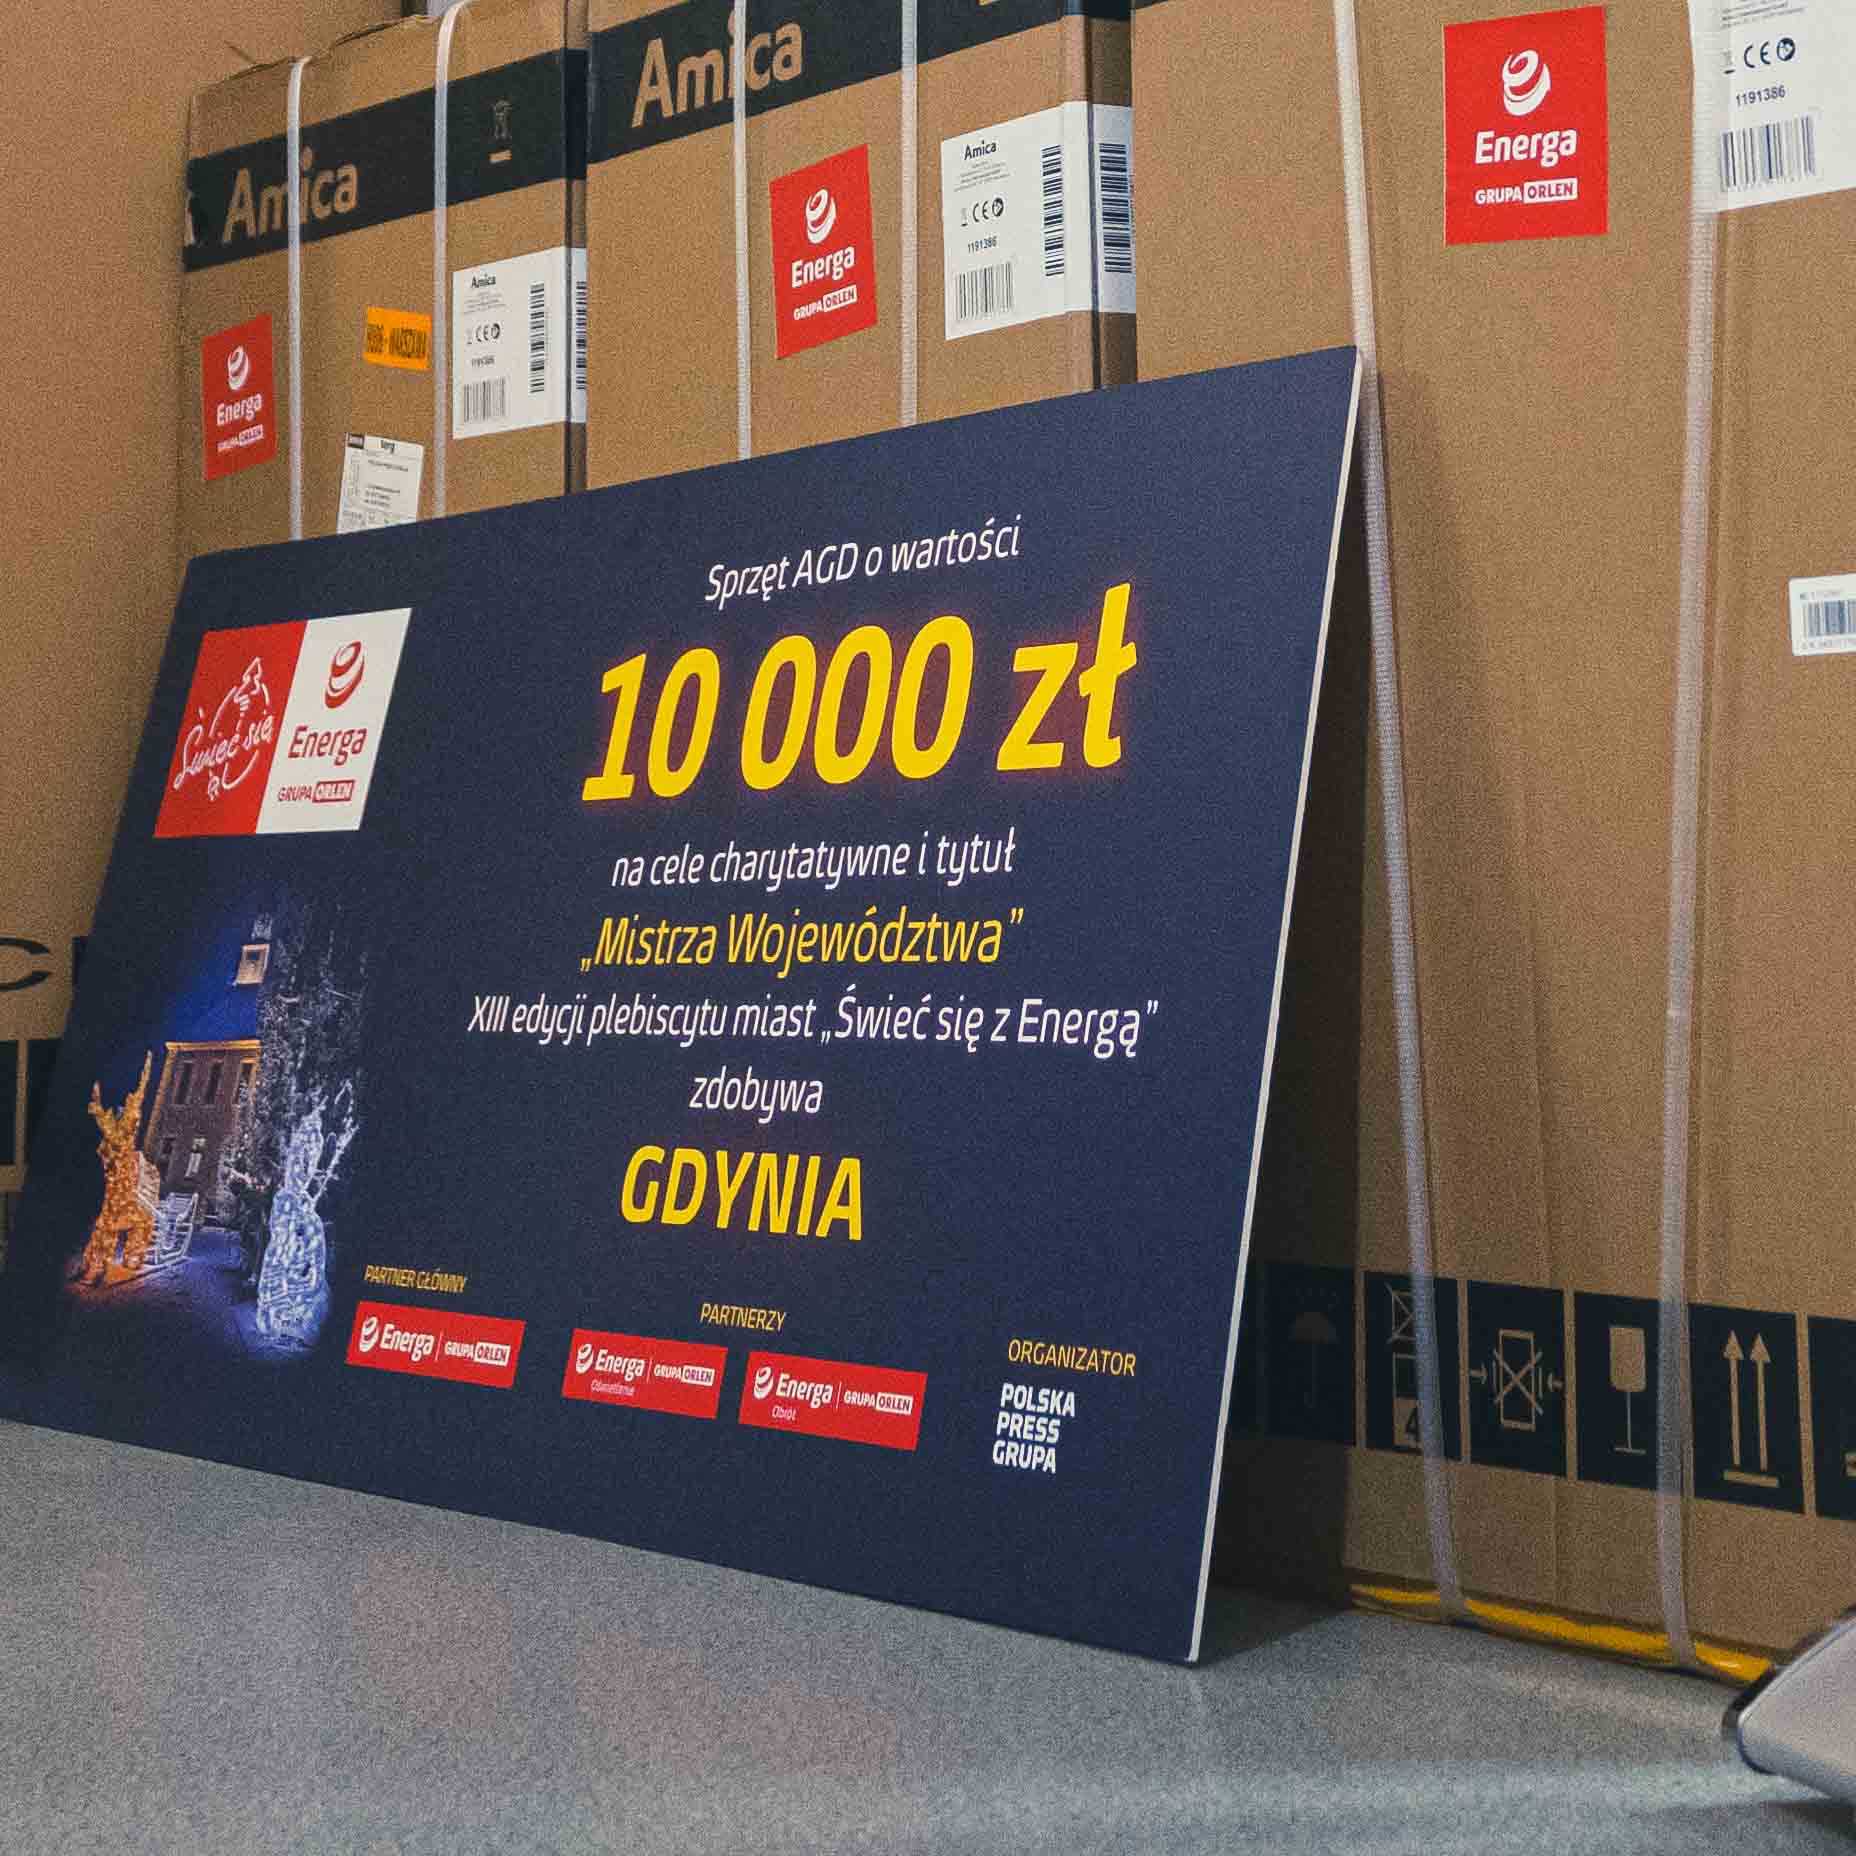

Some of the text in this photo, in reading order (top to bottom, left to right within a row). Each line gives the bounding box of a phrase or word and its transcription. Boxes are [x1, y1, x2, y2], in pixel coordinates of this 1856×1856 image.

[1735, 84, 1787, 108] 1191386
[964, 139, 997, 161] Amica
[1475, 129, 1577, 168] Energa
[1475, 180, 1575, 205] GRUPA ORLEN
[471, 273, 497, 289] Amica
[791, 246, 855, 289] Energa
[793, 288, 855, 321] GRUPA ORLEN
[216, 392, 263, 427] Energa
[706, 513, 1023, 611] Sprzęt AGD o wartości
[581, 583, 1137, 801] 10 000 zł
[287, 724, 367, 767] Energa
[277, 784, 313, 803] GRUPA
[611, 826, 1017, 893] na cele charytatywne i tytuł
[579, 904, 1026, 980] „Mistrza Województwa”
[467, 982, 1160, 1061] XIII edycji plebiscytu miast „Świeć się z Energą”
[687, 1064, 825, 1125] zdobywa
[620, 1144, 864, 1242] GDYNIA
[363, 1263, 417, 1289] PARTNER
[699, 1302, 787, 1333] PARTNERZY
[379, 1322, 510, 1365] Energa GRUPA ORLEN
[1008, 1339, 1137, 1376] ORGANIZATOR
[594, 1347, 715, 1385] Energa GRUPA ORLEN
[774, 1372, 913, 1415] Energa GRUPA ORLEN
[999, 1382, 1076, 1418] POLSKA
[995, 1410, 1061, 1444] PRESS
[992, 1439, 1056, 1474] GRUPA
